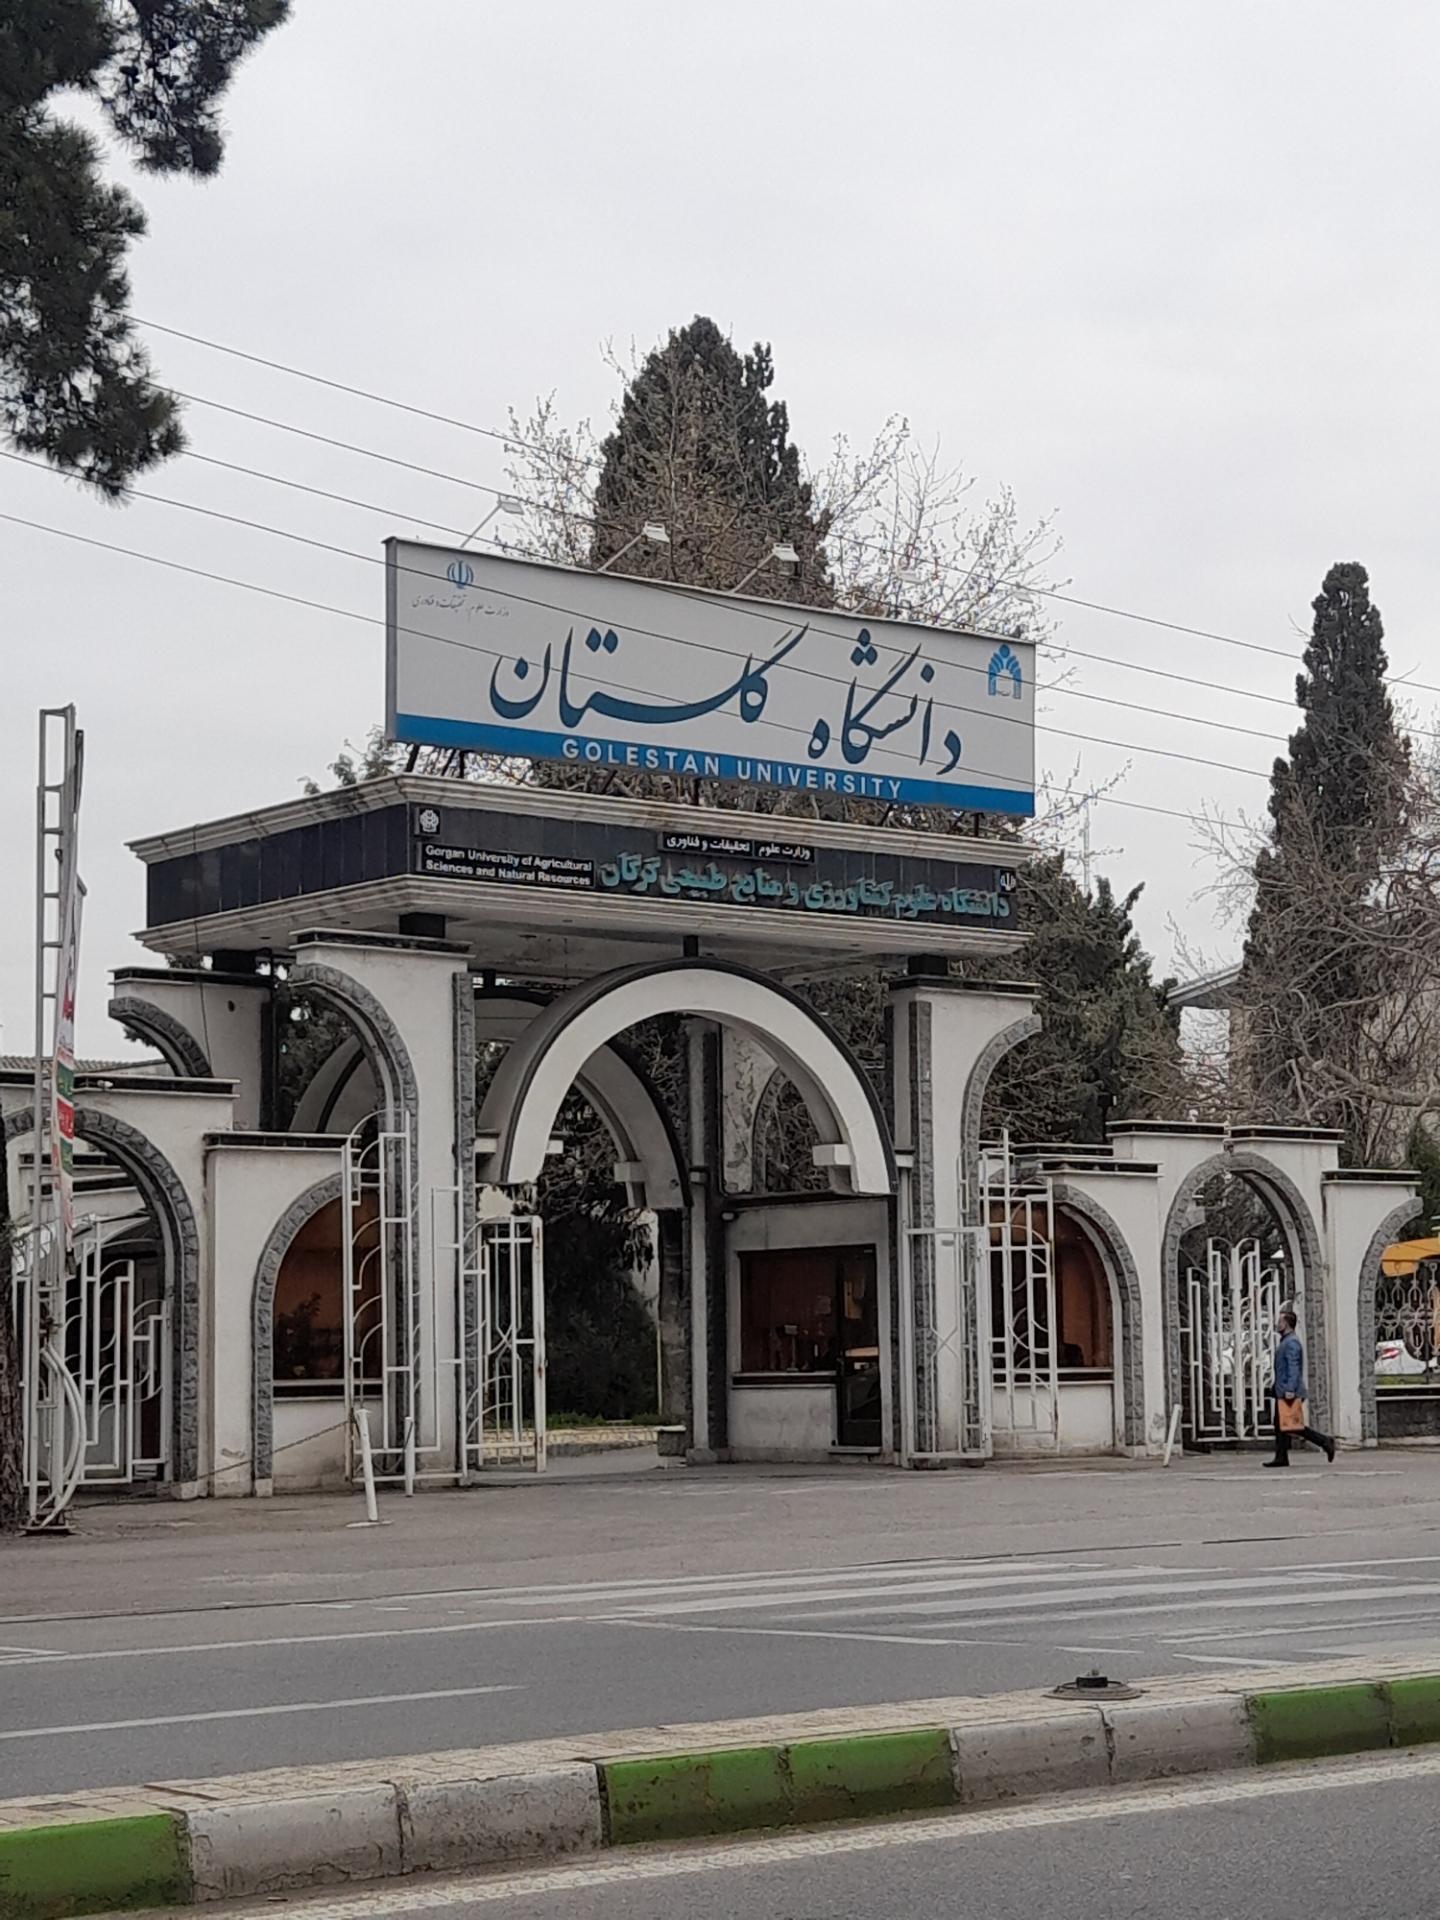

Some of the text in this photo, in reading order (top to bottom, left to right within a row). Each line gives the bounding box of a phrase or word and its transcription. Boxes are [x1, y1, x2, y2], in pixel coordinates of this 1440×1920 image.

[489, 621, 962, 776] دانشگاه گلستان
[562, 737, 902, 800] GOLESTAN UNIVERSITY
[425, 844, 592, 871] Gorgan University of Agricultural
[666, 835, 811, 860] وزارت علوم تحقیقات و فناوری
[425, 859, 591, 886] Sciences and Natural Resources
[599, 851, 1010, 918] دانشگاه علوم کشاورزی و منابع طبیعی گرگان
